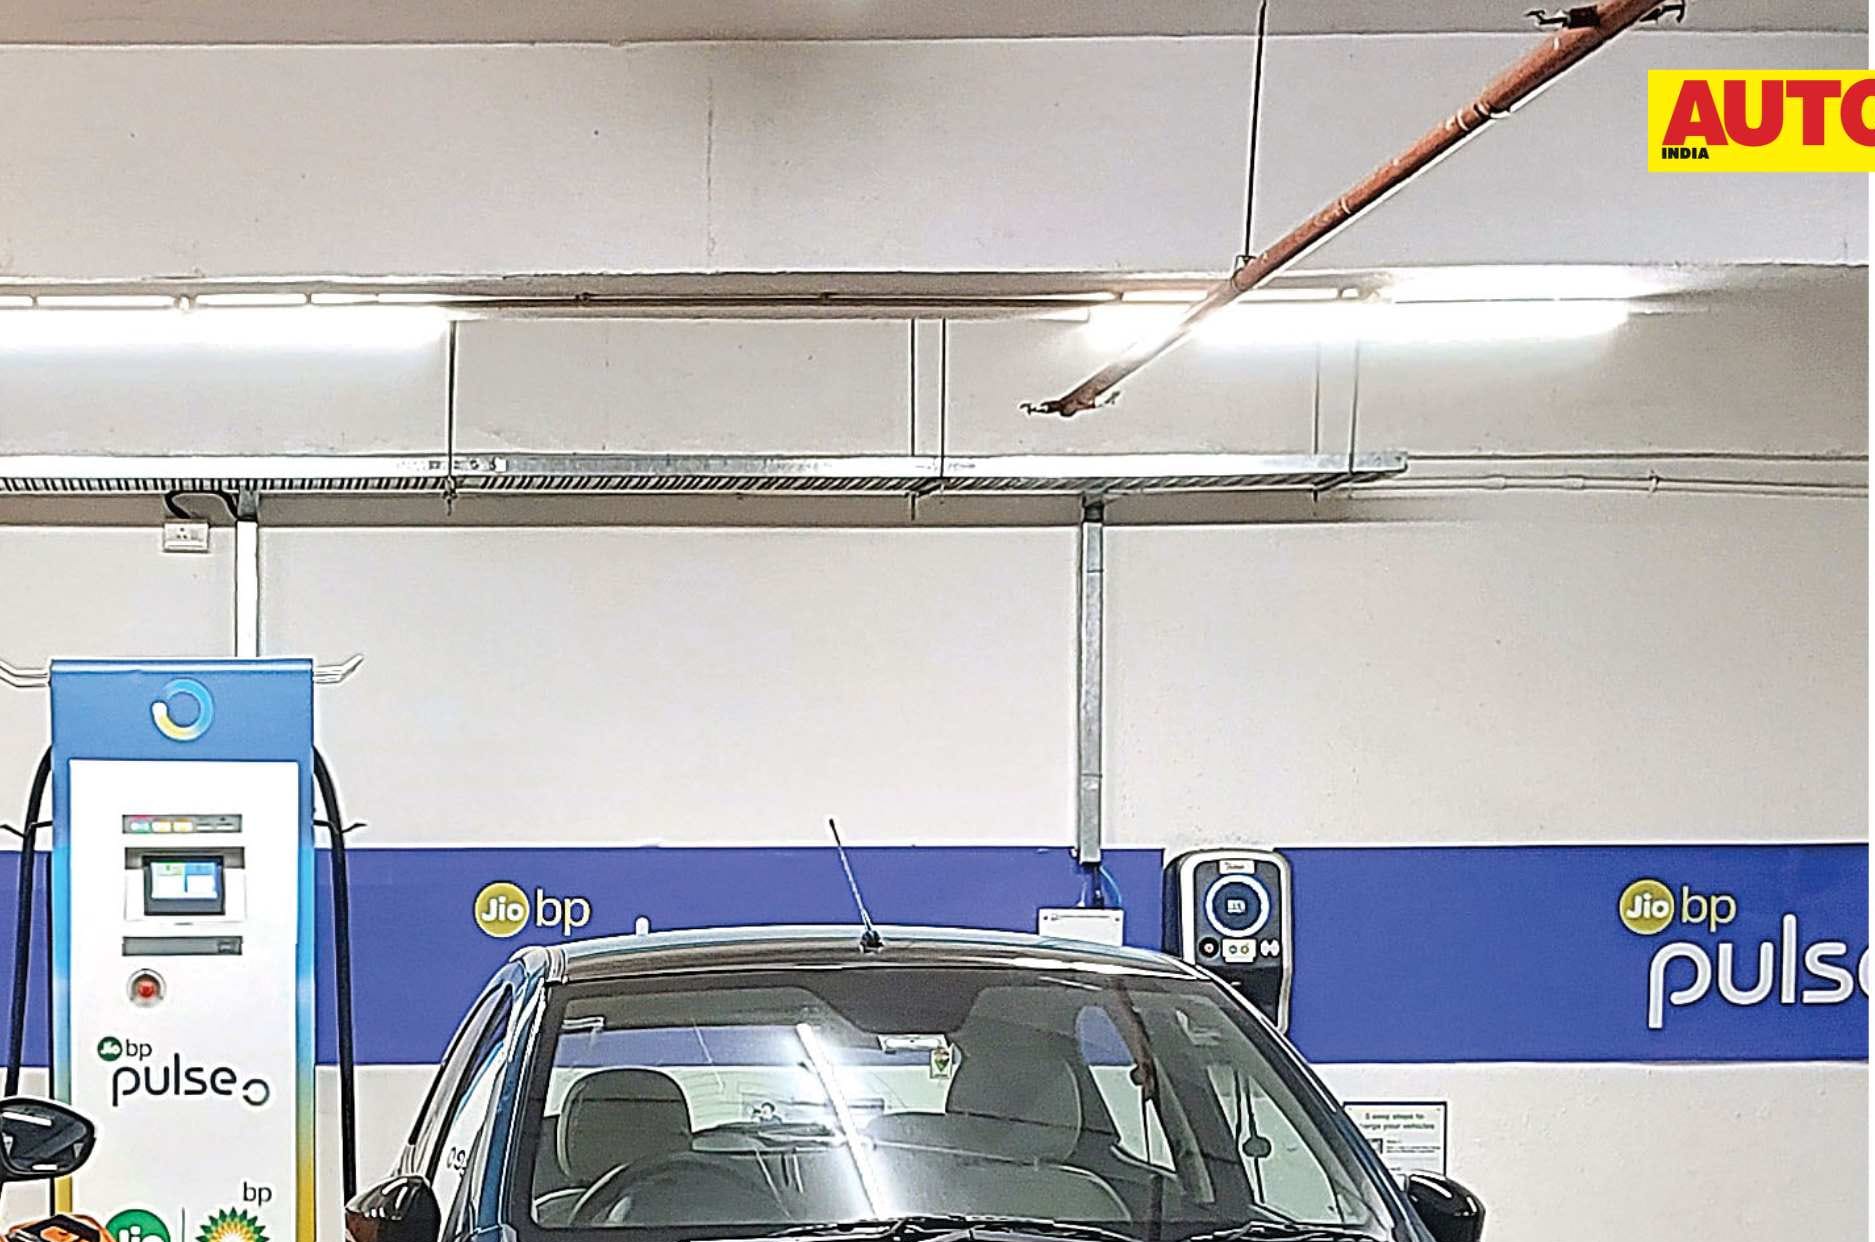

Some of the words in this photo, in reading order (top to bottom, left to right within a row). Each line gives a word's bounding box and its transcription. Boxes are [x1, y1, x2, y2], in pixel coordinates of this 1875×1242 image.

[481, 895, 525, 922] Jio
[536, 888, 591, 936] bp
[1627, 893, 1669, 918] Jio
[1681, 886, 1736, 933] bp
[1648, 914, 1869, 1029] puls
[126, 1039, 152, 1061] bp
[112, 1053, 237, 1107] pulse
[243, 1181, 272, 1207] bp
